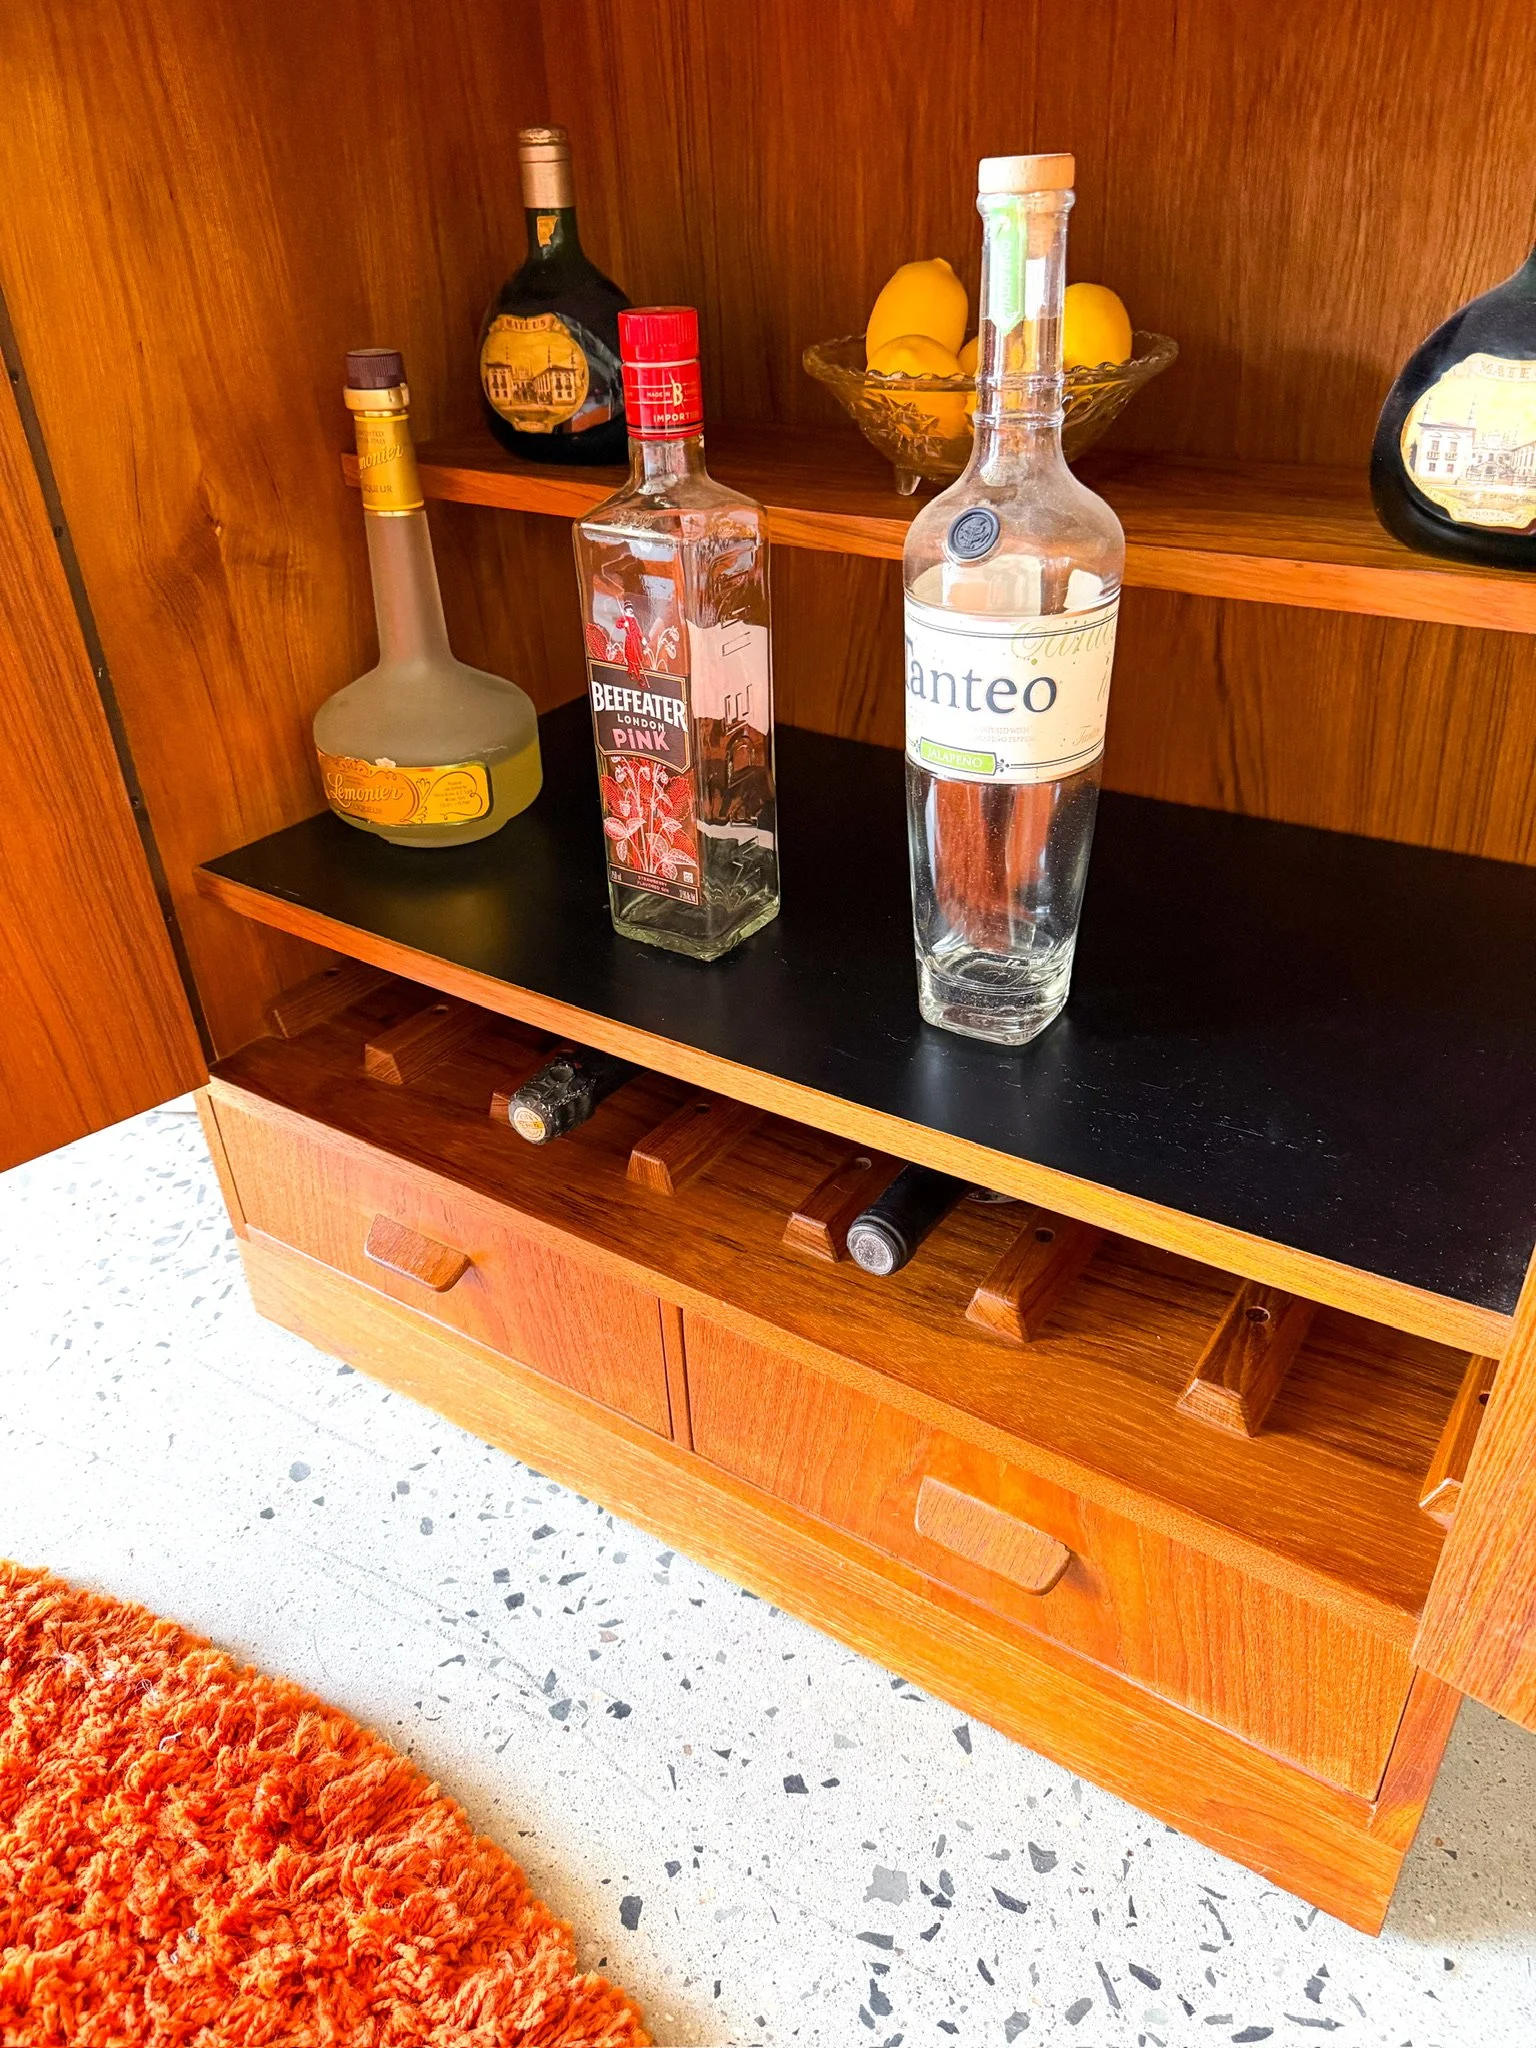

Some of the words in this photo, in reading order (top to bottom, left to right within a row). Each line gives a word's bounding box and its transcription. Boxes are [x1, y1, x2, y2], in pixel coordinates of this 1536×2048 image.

[506, 319, 546, 330] MATEUS
[1480, 361, 1536, 379] MATE
[672, 382, 683, 407] B
[359, 444, 404, 471] monier
[591, 680, 689, 733] BEEFEATER
[617, 713, 666, 732] LONDON
[327, 772, 404, 808] Lemonier
